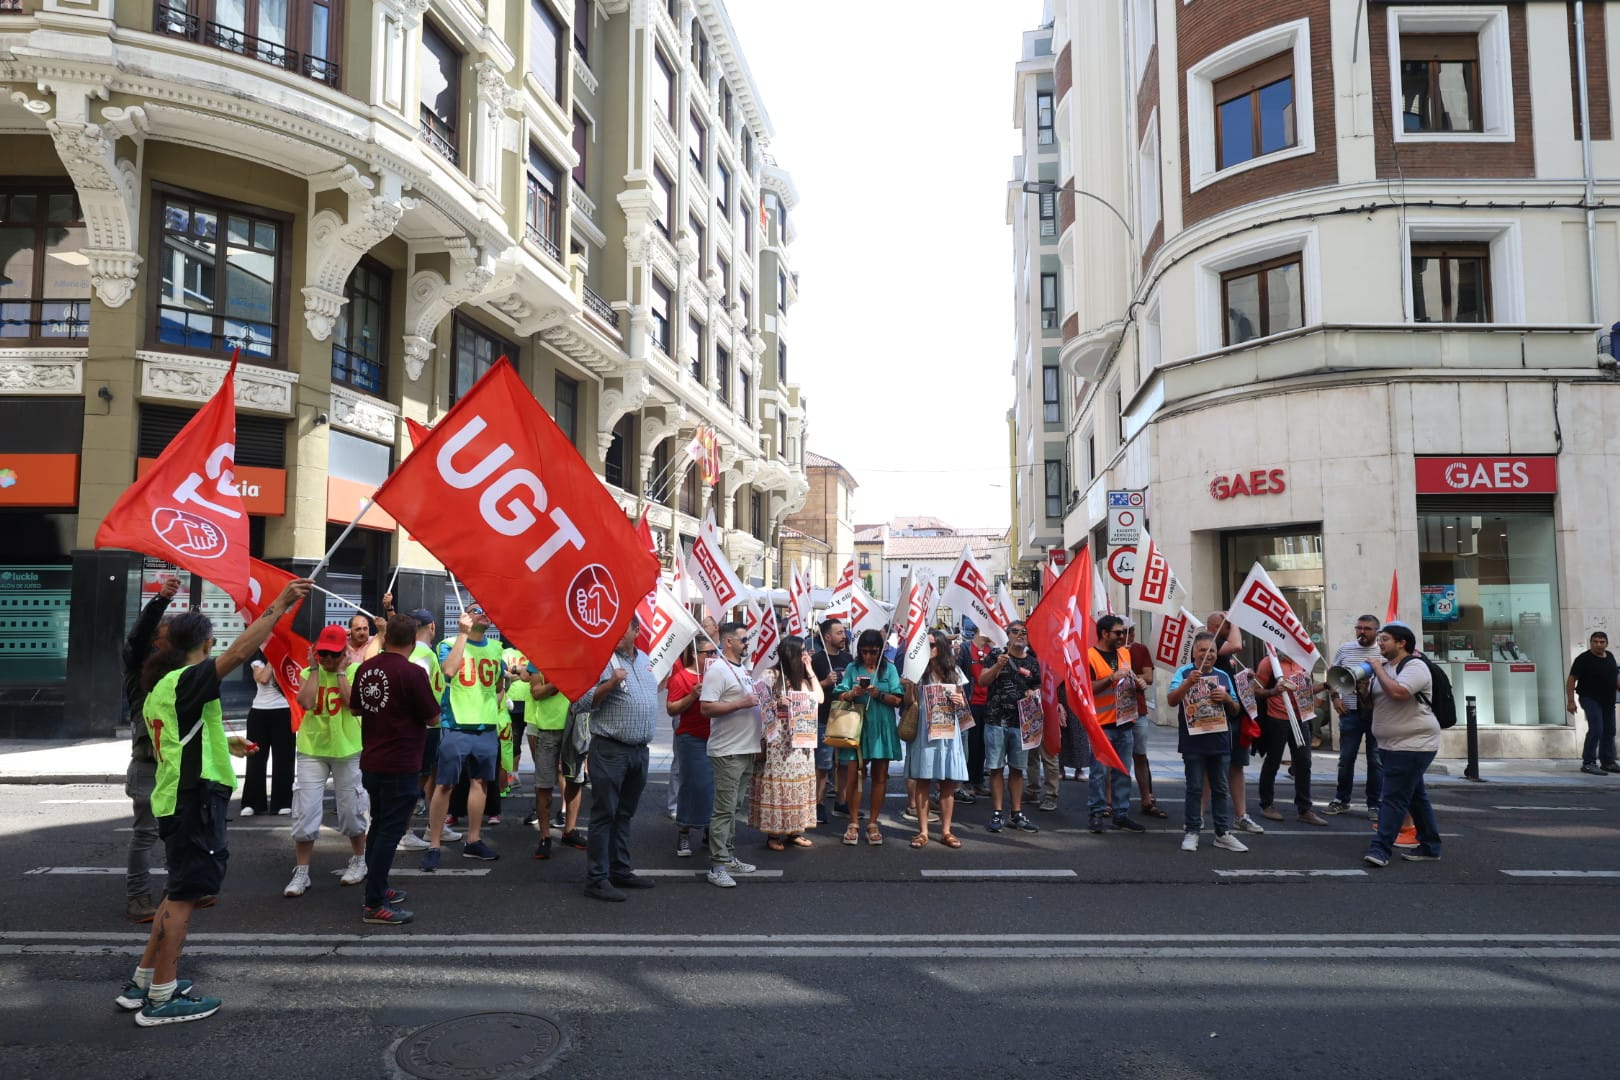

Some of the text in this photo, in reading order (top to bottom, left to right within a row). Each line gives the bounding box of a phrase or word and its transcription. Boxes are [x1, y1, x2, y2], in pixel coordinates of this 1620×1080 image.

[1209, 469, 1286, 500] GAES
[1445, 462, 1529, 489] GAES
[436, 415, 586, 573] UGT
[695, 540, 732, 601] CCOO
[698, 570, 712, 592] León
[971, 599, 989, 620] León
[1250, 587, 1312, 646] CCOO
[662, 632, 677, 652] León
[1261, 620, 1287, 640] León
[908, 632, 928, 660] Castilla
